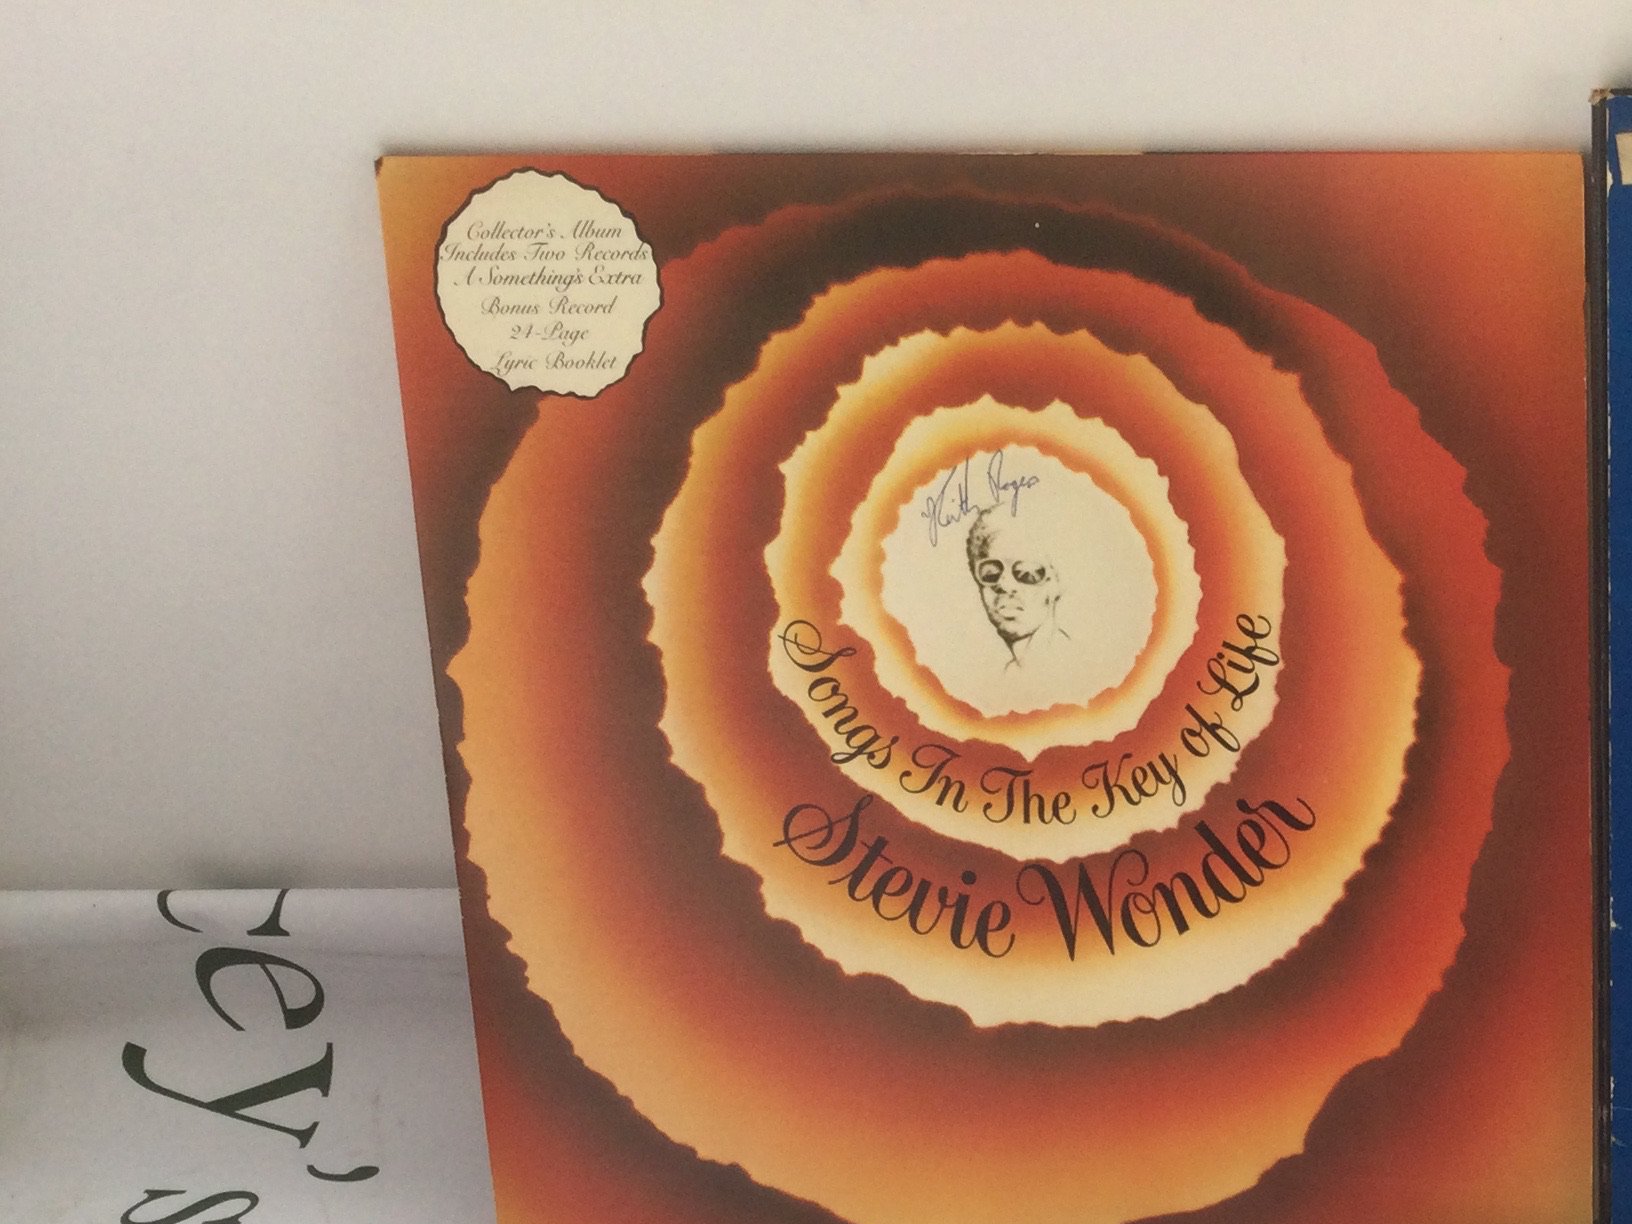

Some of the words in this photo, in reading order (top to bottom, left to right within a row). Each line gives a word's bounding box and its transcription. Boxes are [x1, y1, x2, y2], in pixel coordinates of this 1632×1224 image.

[440, 242, 516, 262] Includes
[523, 242, 566, 261] Two
[574, 242, 648, 262] Records
[467, 221, 555, 240] Collector's
[560, 220, 622, 239] Album
[588, 265, 642, 285] Extra
[481, 296, 540, 316] Bonus
[549, 295, 618, 315] Record
[510, 321, 589, 346] 24-Page
[490, 351, 537, 375] Lyric
[546, 350, 618, 370] Booklet
[1197, 612, 1281, 711] Life
[777, 619, 903, 764] Songs
[1181, 703, 1241, 758] of
[899, 744, 968, 813] In
[982, 766, 1077, 825] The
[1081, 752, 1187, 818] Key
[773, 794, 1015, 958] Stevie
[1016, 796, 1316, 962] Wonder
